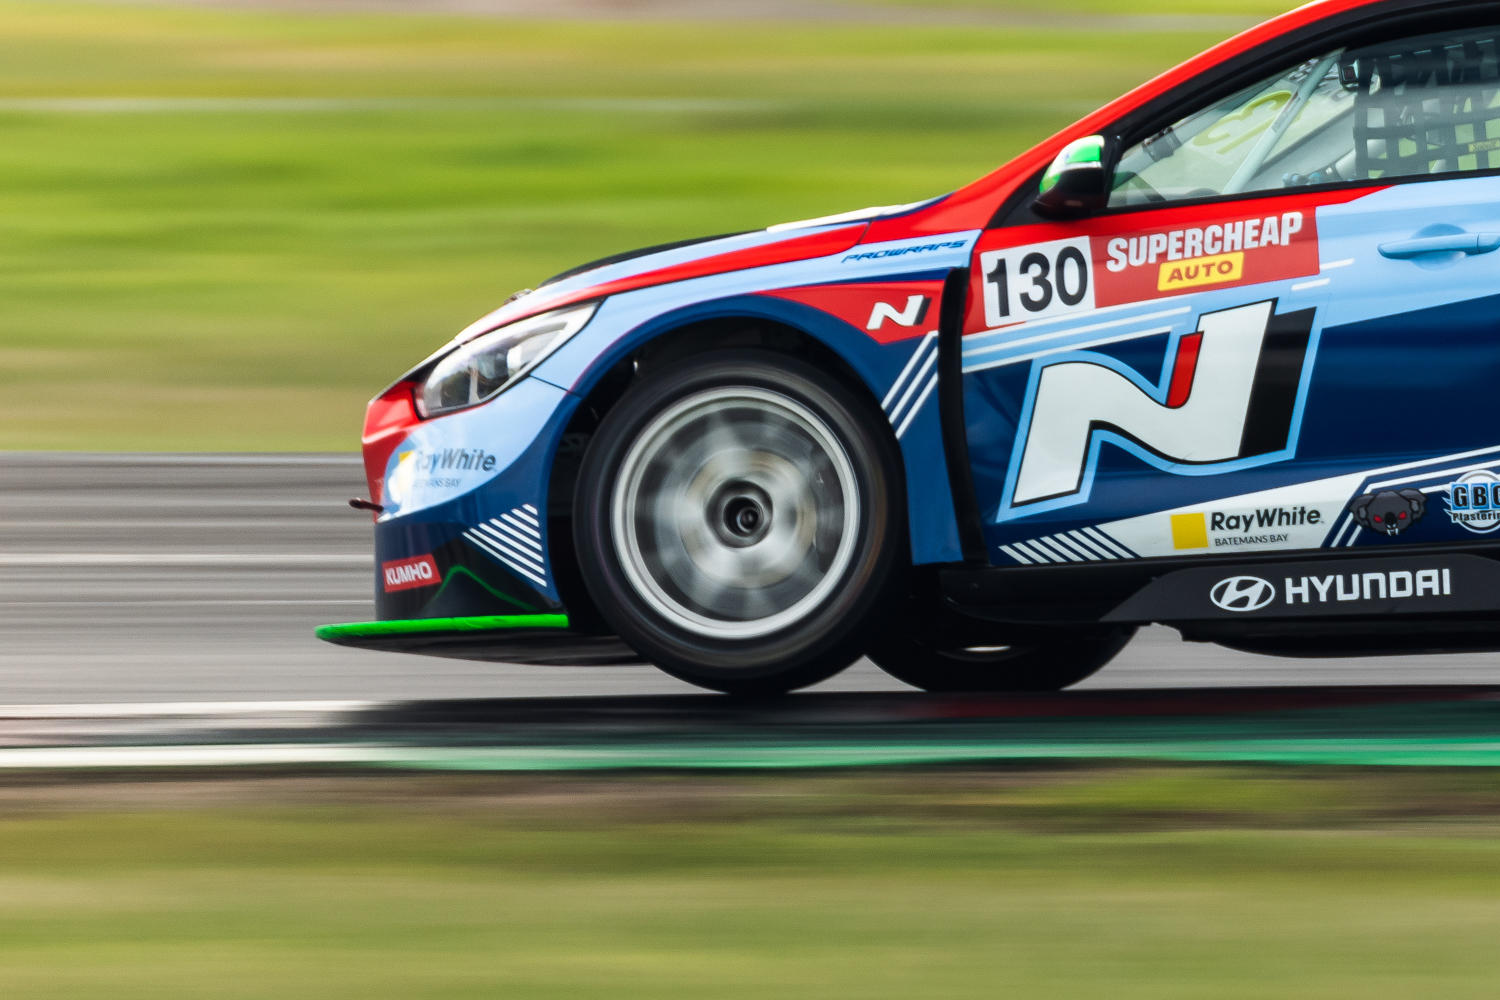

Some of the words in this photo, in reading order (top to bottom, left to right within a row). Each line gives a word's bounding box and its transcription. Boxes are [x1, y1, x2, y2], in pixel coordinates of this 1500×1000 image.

[840, 239, 969, 264] PROWRAPS
[1105, 211, 1303, 273] SUPERCHEAP
[986, 246, 1088, 318] 130
[1166, 260, 1234, 283] AUTO
[1215, 534, 1268, 547] BATEMANS
[1269, 534, 1289, 543] BAY
[384, 561, 433, 586] KUMHO
[1285, 568, 1451, 605] HYUNDAI
